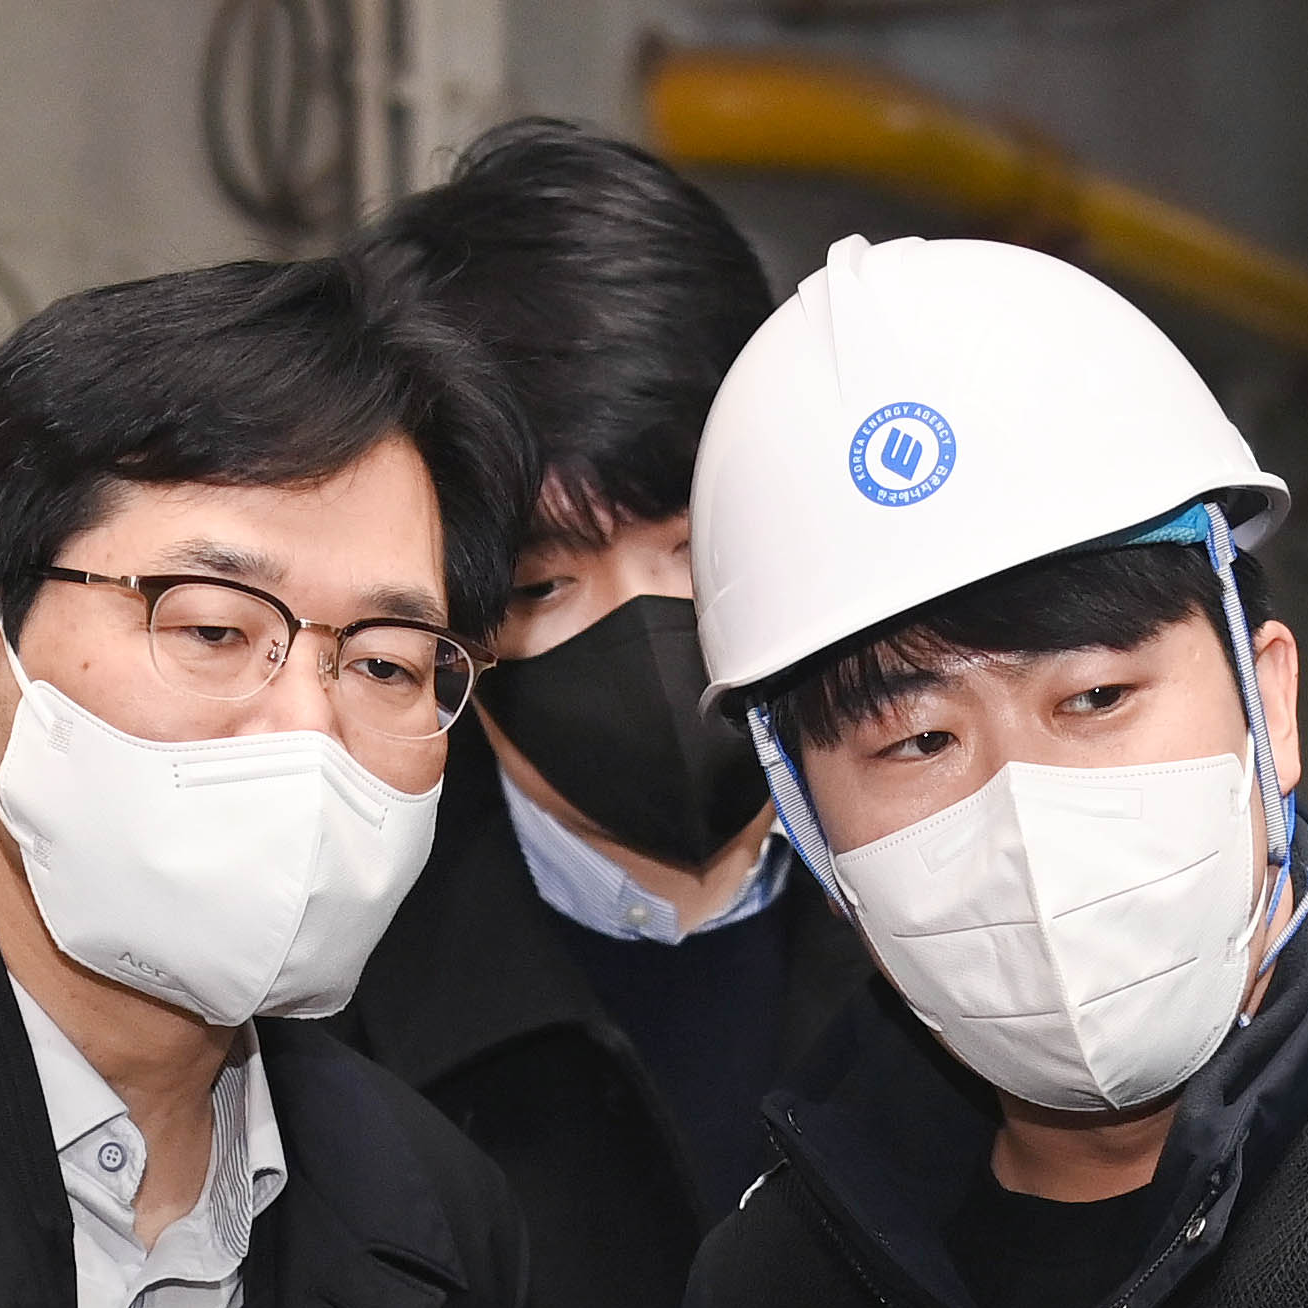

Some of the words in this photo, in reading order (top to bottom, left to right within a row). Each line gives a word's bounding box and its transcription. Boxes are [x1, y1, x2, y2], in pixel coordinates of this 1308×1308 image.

[852, 438, 866, 481] KOREA
[861, 405, 910, 435] ENERGY
[913, 407, 952, 445] AGENCY
[876, 464, 949, 504] 한국에너지공단
